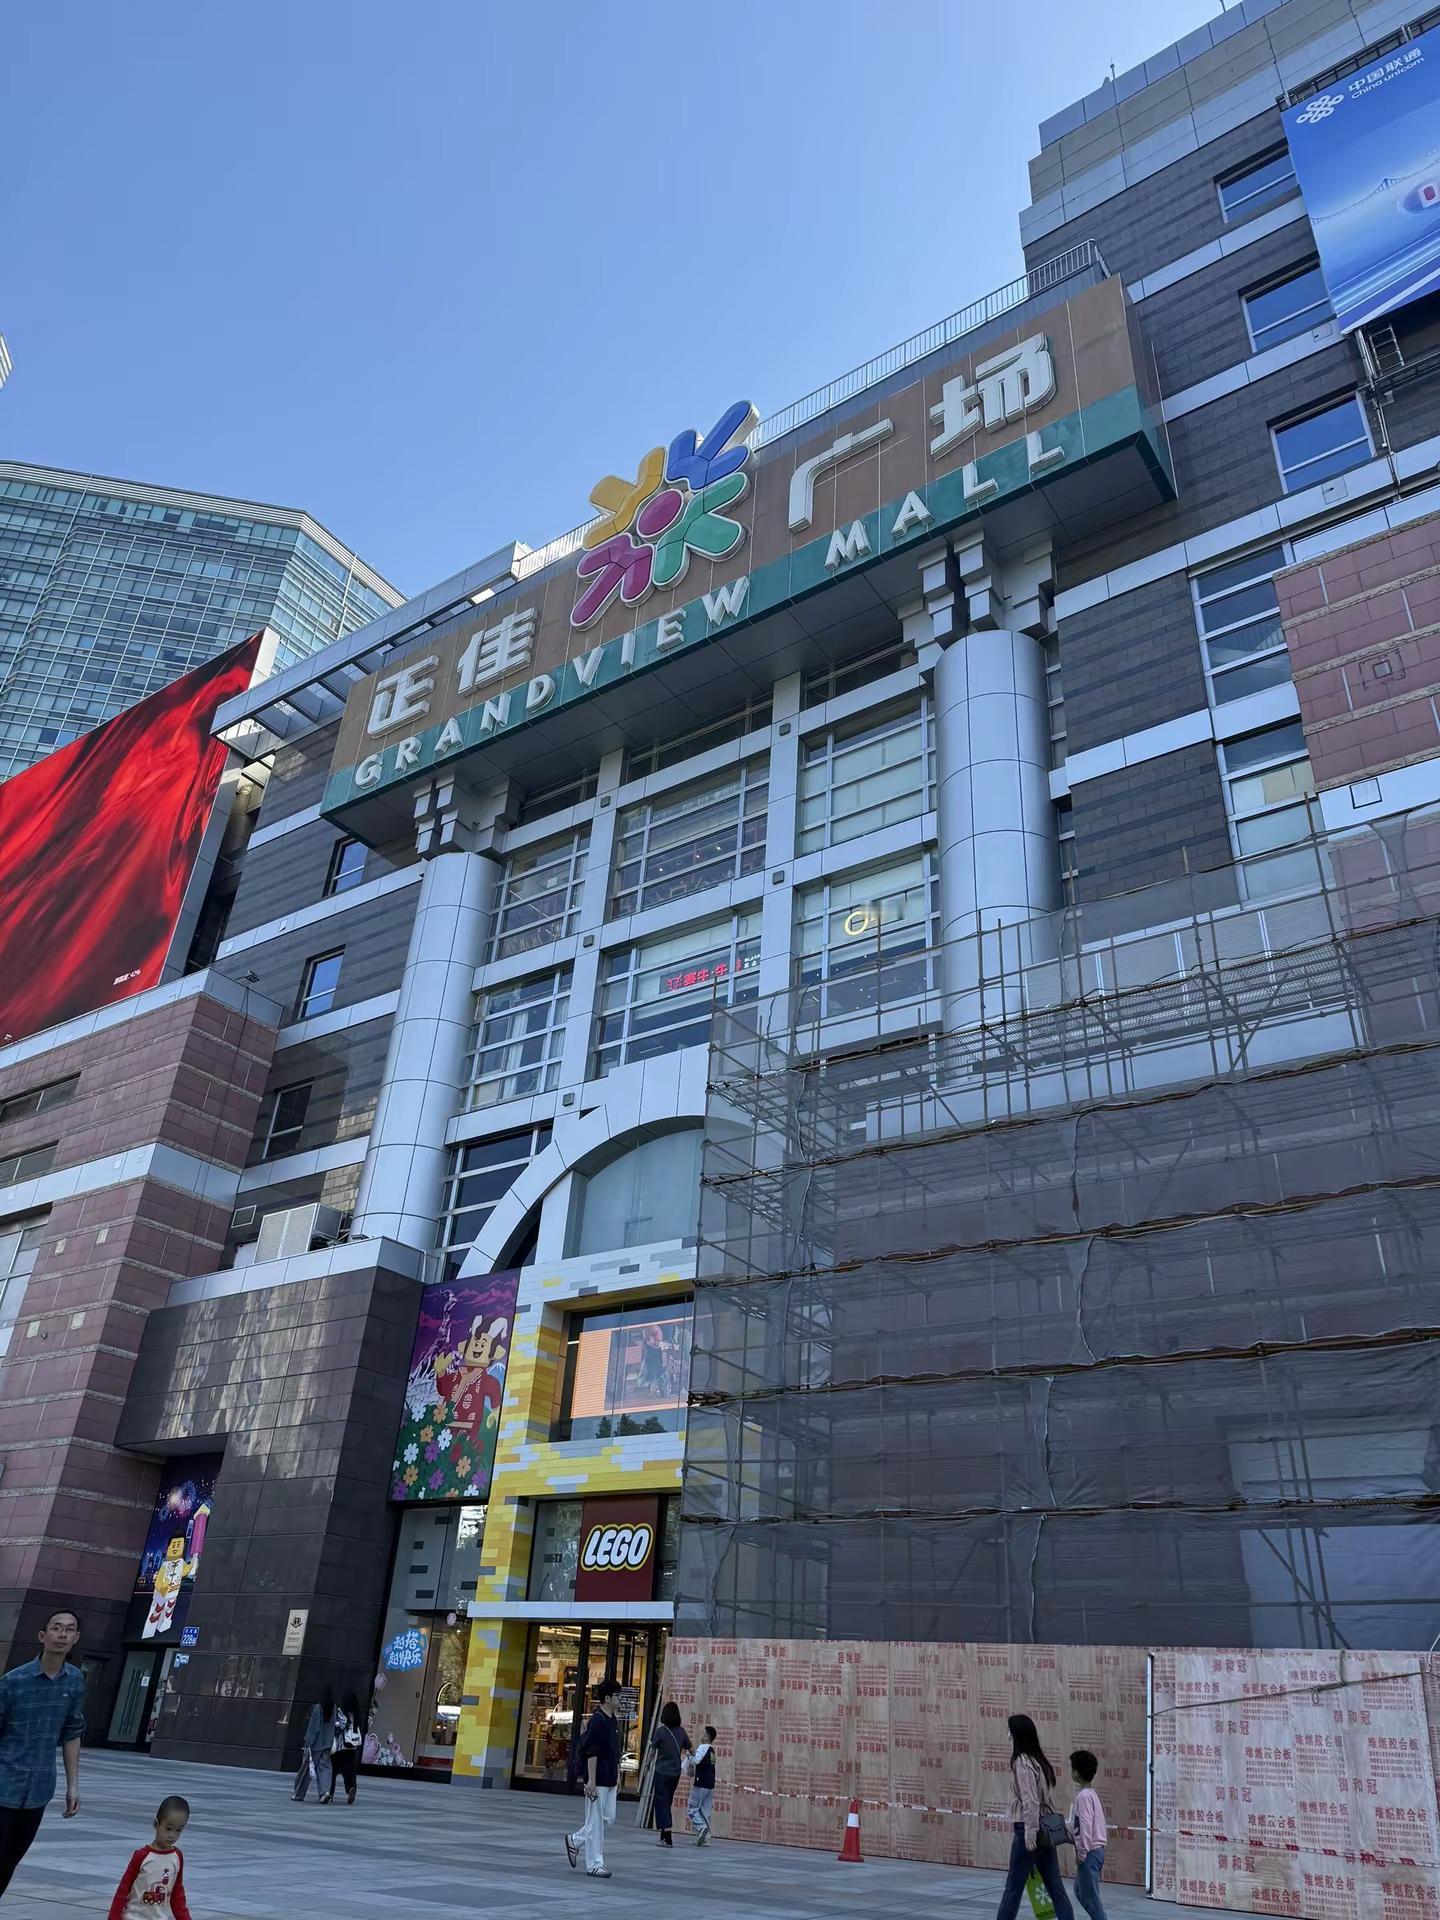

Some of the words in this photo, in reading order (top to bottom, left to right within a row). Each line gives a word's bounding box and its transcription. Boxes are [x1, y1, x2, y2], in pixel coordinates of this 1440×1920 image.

[1348, 47, 1422, 91] 中国联通
[1351, 79, 1383, 99] China
[1383, 57, 1425, 82] unicom
[366, 607, 538, 738] 正佳
[788, 331, 1057, 533] 广场
[354, 576, 750, 789] GRANDVIEW
[825, 428, 1066, 571] MALL
[584, 1528, 650, 1566] LEGO
[387, 1648, 422, 1668] 越快乐
[1215, 1786, 1253, 1803] 御和冠
[1338, 1776, 1378, 1795] 御和冠
[1218, 1854, 1255, 1872] 御和冠
[1179, 1879, 1227, 1896] 难燃胶合板
[1304, 1873, 1357, 1891] 难燃胶合板
